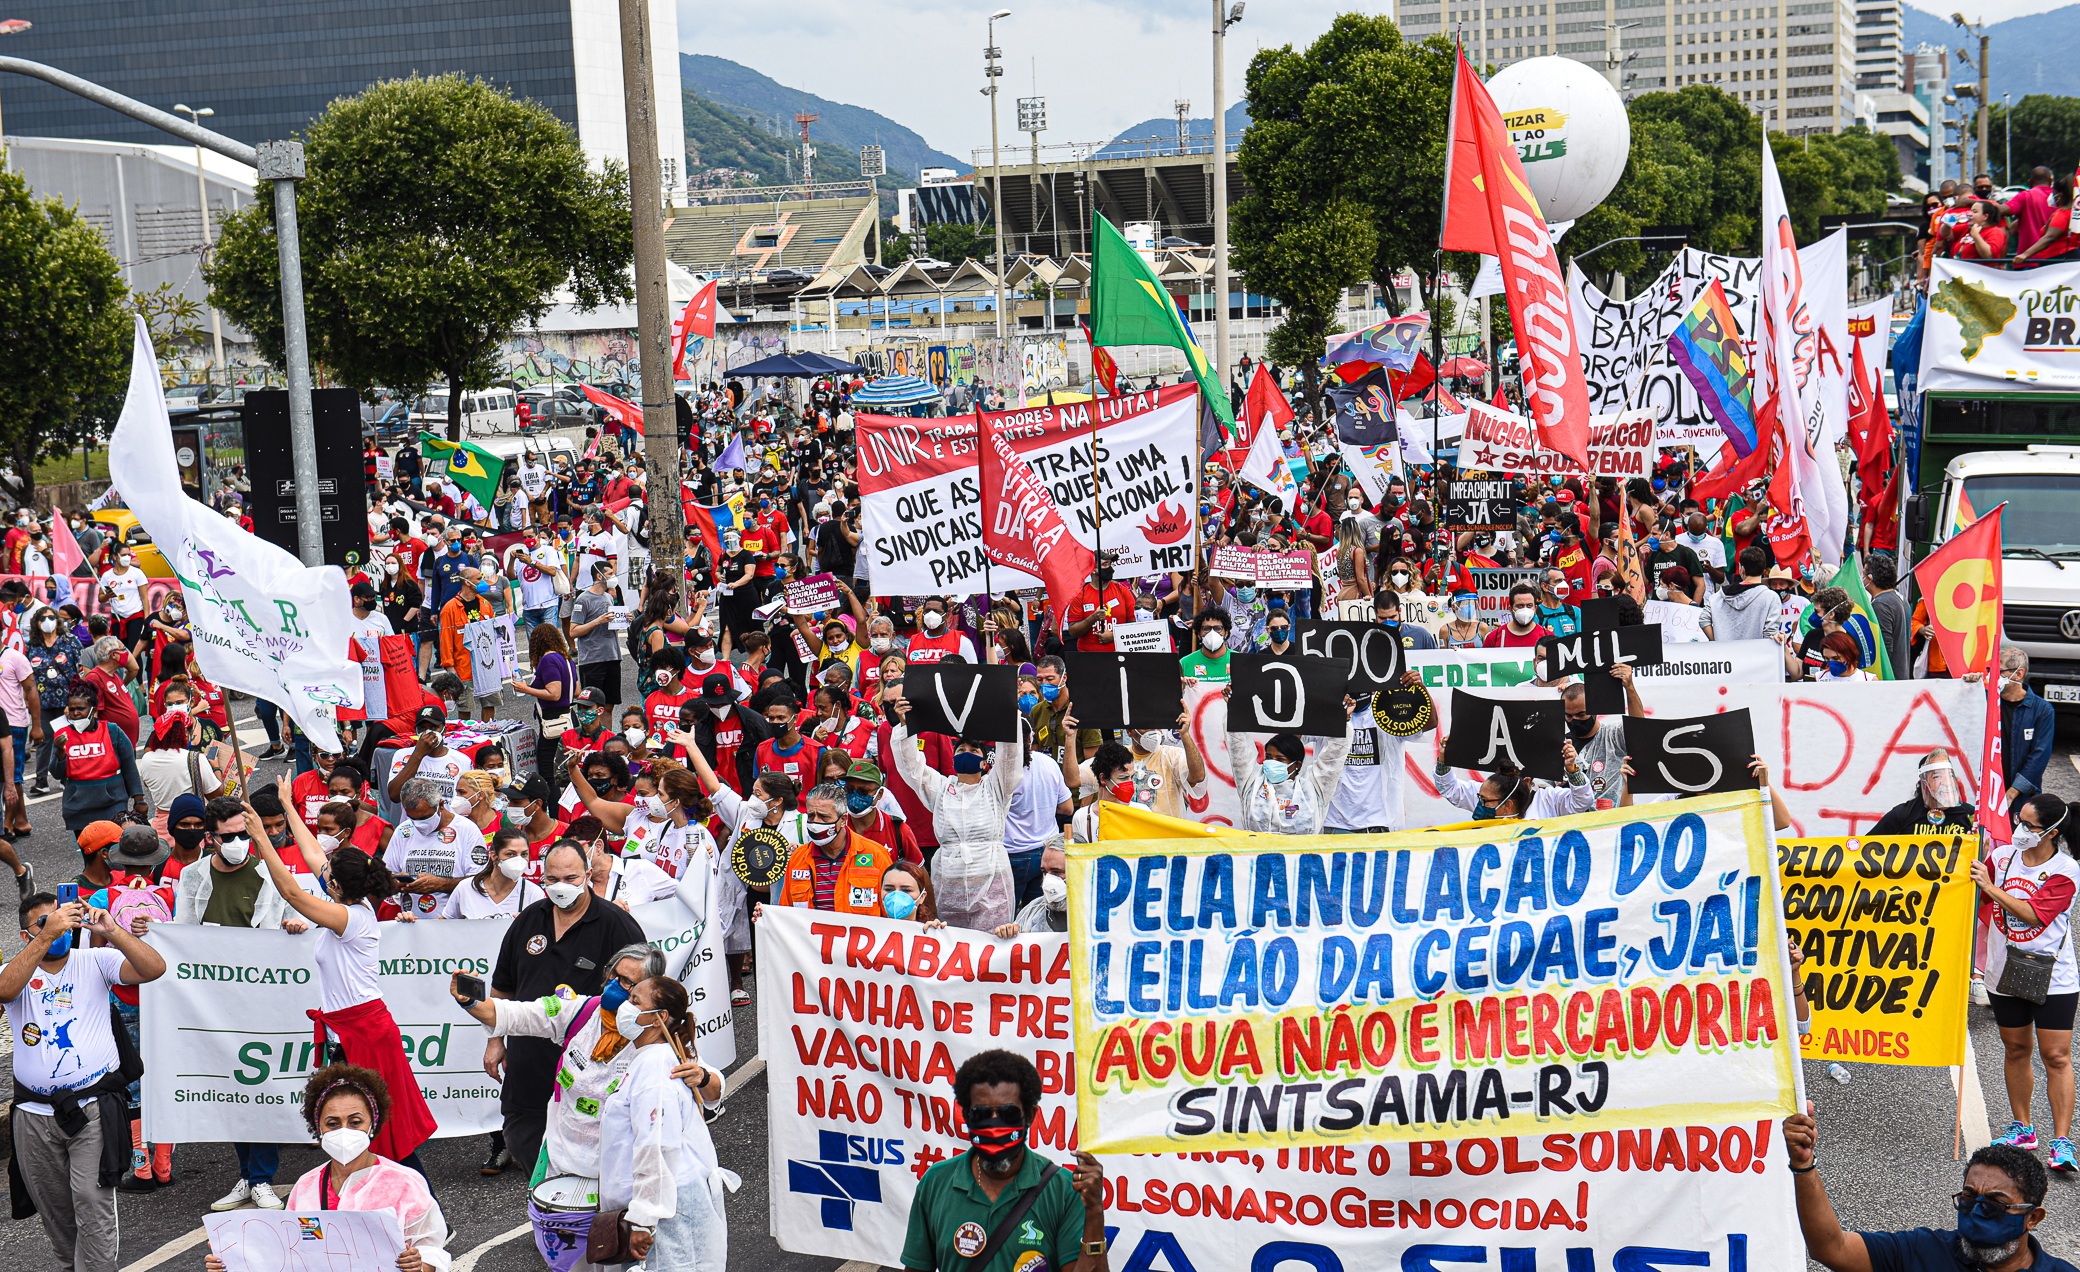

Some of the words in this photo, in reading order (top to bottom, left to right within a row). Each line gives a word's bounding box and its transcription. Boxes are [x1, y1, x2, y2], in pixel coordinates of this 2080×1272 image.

[1524, 128, 1545, 140] AO
[2023, 317, 2080, 346] BR
[933, 443, 943, 459] E
[1059, 403, 1090, 432] NA
[1099, 389, 1161, 423] LUTA!
[858, 423, 931, 477] UNIR
[1480, 452, 1494, 461] PT
[524, 471, 540, 480] FORA
[895, 488, 944, 523] QUE
[952, 477, 981, 506] AS
[1116, 443, 1167, 482] UMA
[1450, 481, 1513, 500] IMPEACHMENT
[875, 511, 983, 568] SINDICAIS
[1077, 455, 1195, 534] NACIONAL!
[1448, 523, 1514, 532] #BOLSONAROGENOCIDA
[1465, 499, 1491, 525] JÁ
[743, 540, 761, 549] PSTU
[1149, 544, 1192, 571] MRT
[1215, 555, 1248, 563] MOURÃO
[1256, 557, 1308, 566] BOLSONARO,
[1264, 569, 1309, 577] MILITARES!
[786, 580, 805, 590] FORA
[787, 580, 831, 595] BOLSONARO,
[789, 589, 818, 601] MOURÃO
[796, 590, 834, 604] MILITARES!
[1131, 637, 1161, 646] MATANDO
[1134, 644, 1157, 652] BRASIL!
[1301, 628, 1399, 684] 500
[933, 671, 983, 734] V
[1376, 703, 1429, 738] BOLSONARO
[1477, 704, 1525, 771] A
[1656, 723, 1723, 793] S
[736, 846, 751, 878] FORA
[754, 832, 786, 880] BOLSONARO
[1777, 844, 1844, 880] PELO
[1854, 835, 1963, 884] SUS!
[1095, 853, 1237, 933] PELA
[1251, 826, 1592, 928] ANULAÇÃO
[1614, 812, 1707, 896] DO
[810, 921, 1071, 985] TRABALHA
[1094, 928, 1300, 1015] LEILÃO
[1319, 932, 1395, 1004] DA
[1649, 869, 1761, 971] JÁ!
[176, 962, 311, 985] SINDICATO
[379, 952, 490, 976] MÉDICOS
[791, 971, 925, 1031] LINHA
[932, 1000, 974, 1034] DE
[989, 992, 1071, 1040] FRE
[1095, 1017, 1264, 1083] ÁGUA
[1281, 1004, 1397, 1075] NÃO
[1410, 990, 1445, 1063] É
[1453, 977, 1779, 1061] MERCADORIA
[1823, 1027, 1910, 1059] ANDES
[791, 1024, 957, 1086] VACINA
[174, 1089, 250, 1106] Sindicato
[254, 1091, 284, 1106] dos
[420, 1086, 439, 1100] de
[442, 1085, 500, 1100] Janeiro
[796, 1073, 883, 1125] NÃO
[1173, 1060, 1610, 1136] SINTSAMA-RJ
[847, 1134, 905, 1165] SUS
[1408, 1120, 1773, 1177] BOLSONARO!
